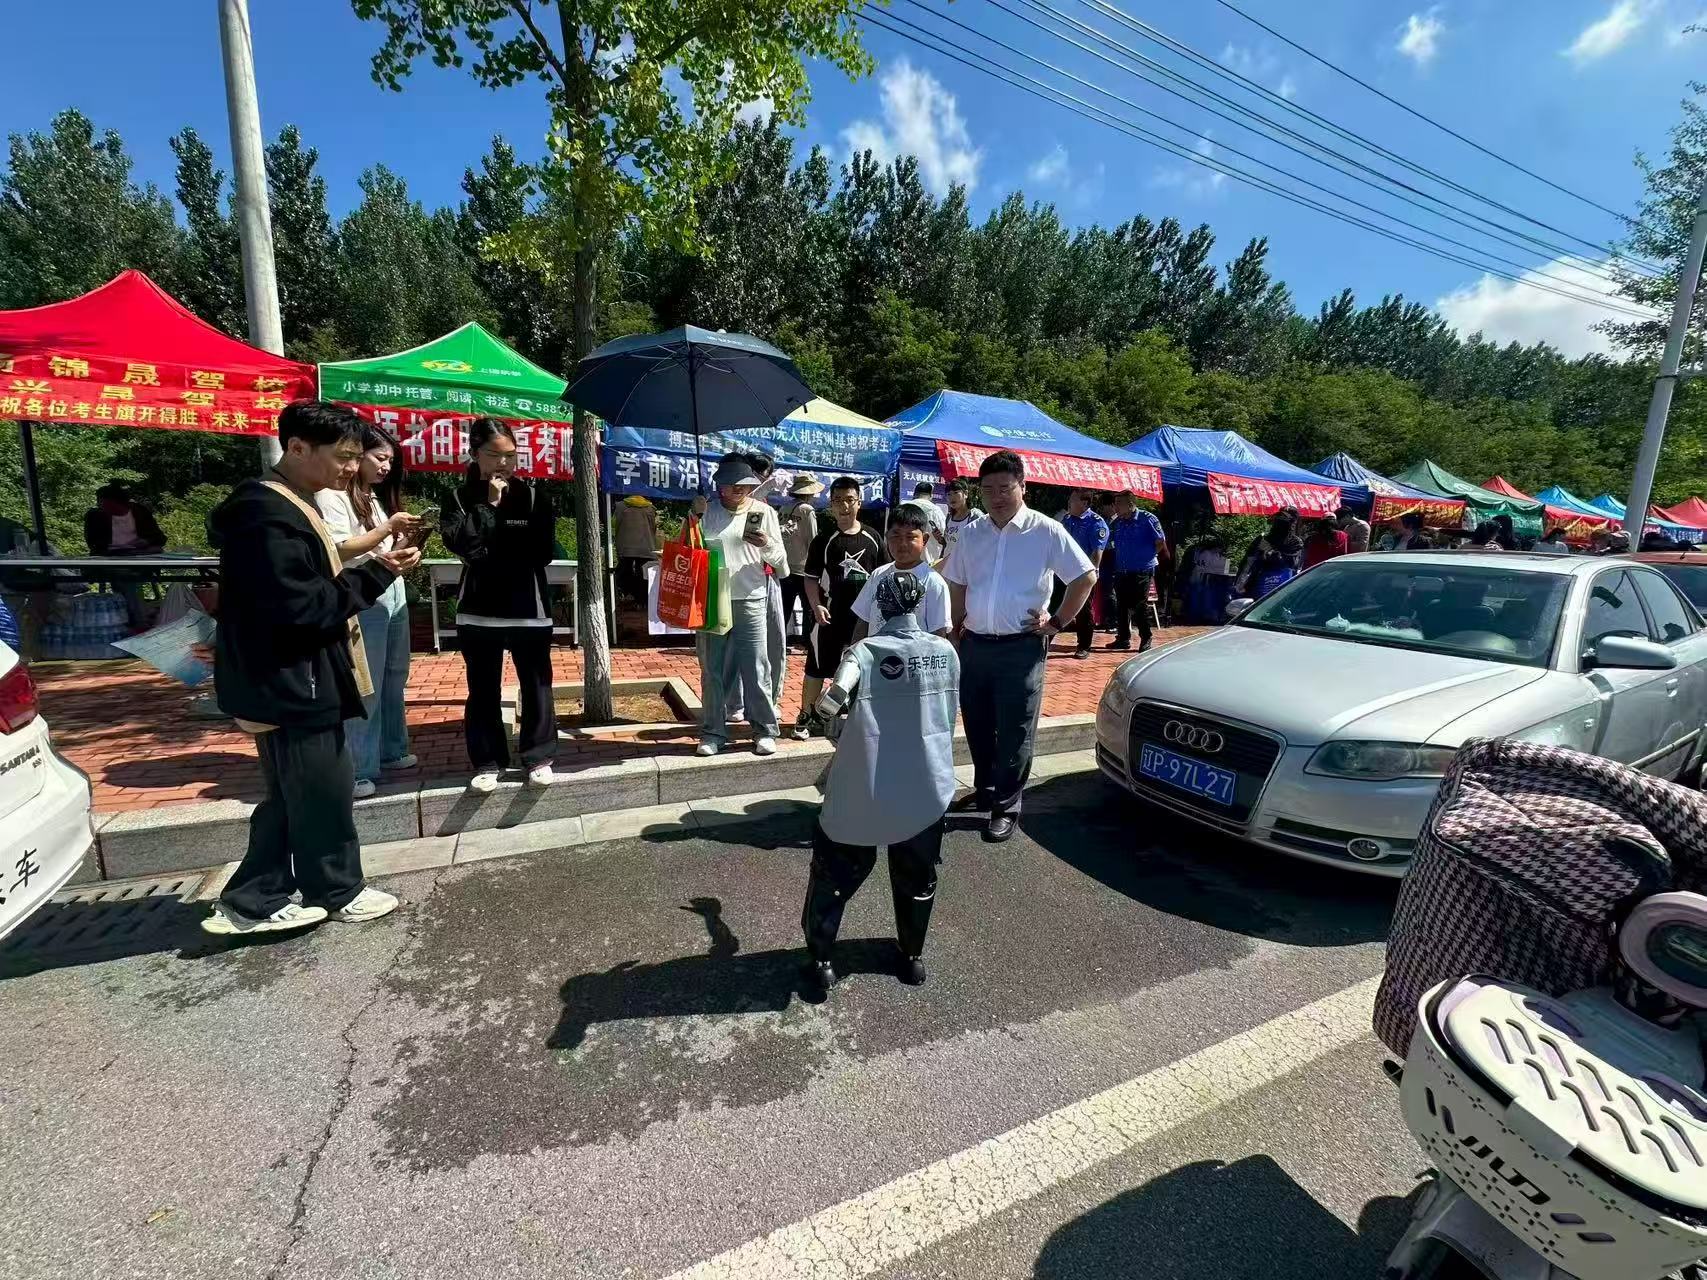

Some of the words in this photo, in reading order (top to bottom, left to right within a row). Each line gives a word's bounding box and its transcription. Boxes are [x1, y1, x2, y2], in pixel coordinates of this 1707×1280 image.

[0, 352, 288, 395] 锦晟驾校
[1, 396, 198, 426] 祝各位考生旗开得胜
[212, 411, 279, 430] 未来一
[908, 654, 948, 672] 乐宇航空
